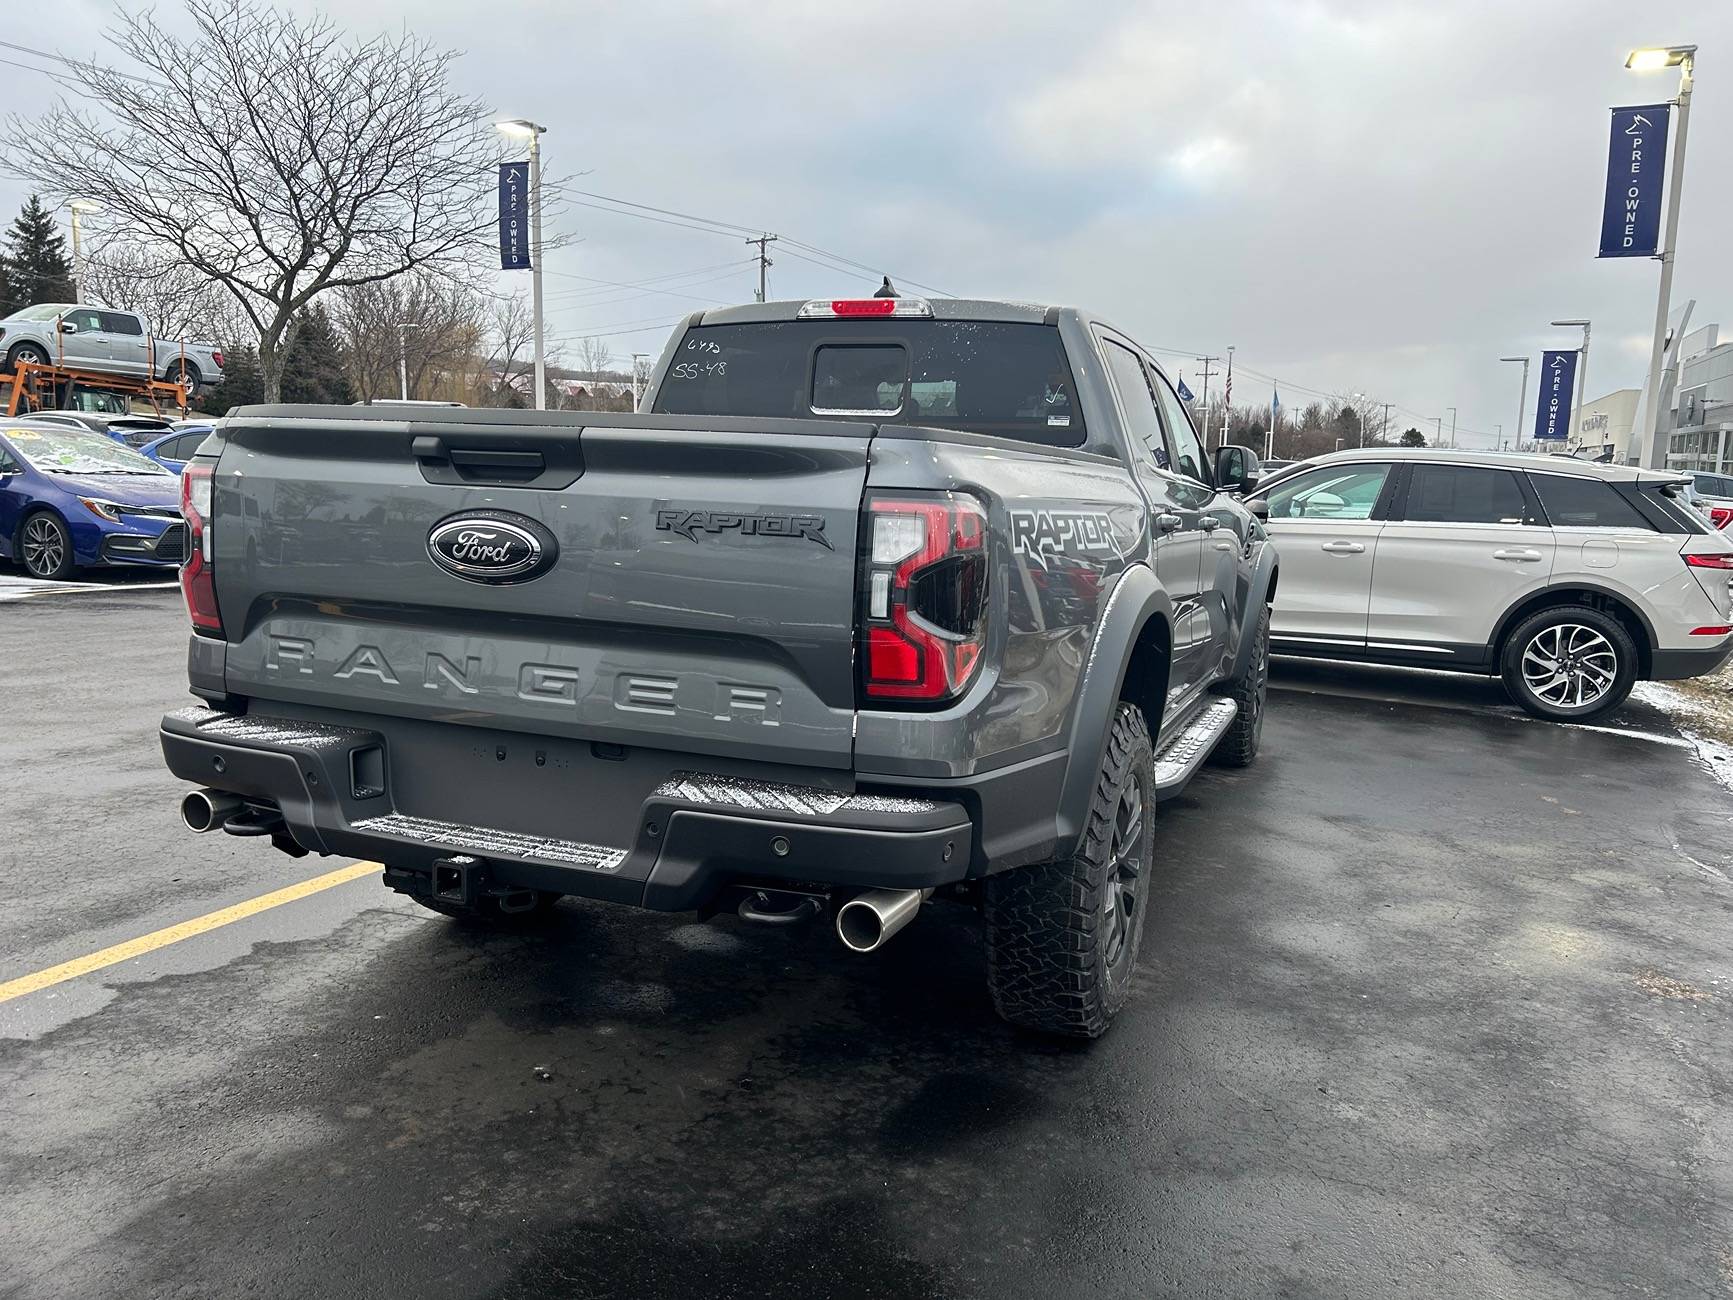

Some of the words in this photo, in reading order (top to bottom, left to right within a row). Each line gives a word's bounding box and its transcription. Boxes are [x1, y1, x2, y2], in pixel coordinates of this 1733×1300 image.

[452, 530, 512, 562] Ford
[656, 509, 836, 551] RAPTOR
[1010, 509, 1125, 573] RAPTOR
[265, 633, 784, 727] RANGER
